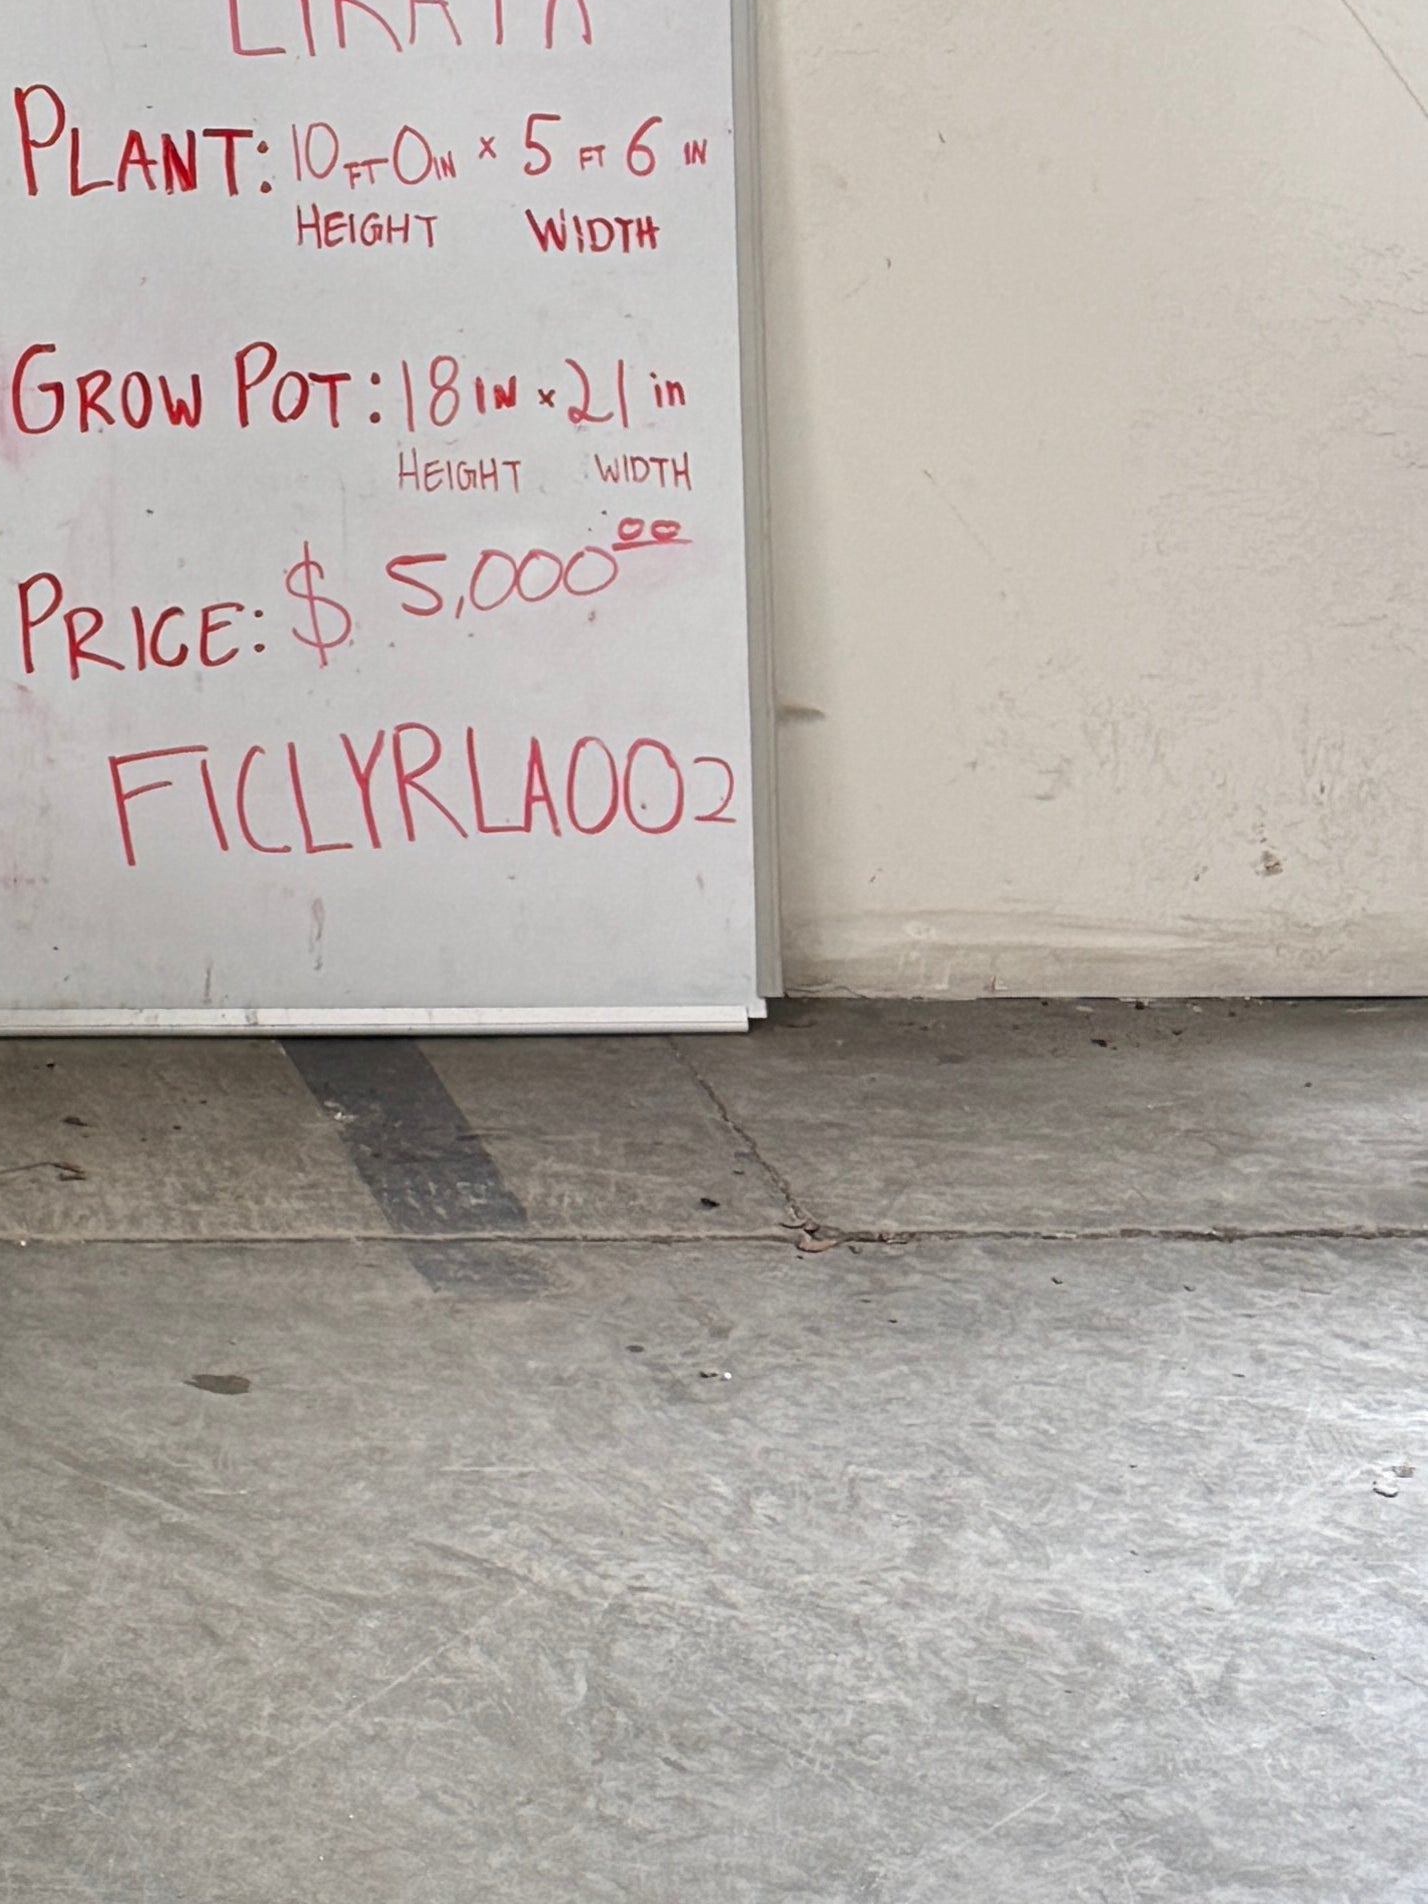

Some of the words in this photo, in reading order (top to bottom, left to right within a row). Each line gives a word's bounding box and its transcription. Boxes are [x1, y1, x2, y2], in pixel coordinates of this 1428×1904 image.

[12, 85, 272, 198] PLANT:
[523, 112, 560, 177] 5
[577, 142, 607, 171] FT
[625, 116, 661, 178] 6
[681, 139, 708, 167] IN
[296, 203, 438, 249] HEIGHT
[525, 210, 660, 254] WIDTH
[11, 343, 203, 435] GROW
[233, 341, 380, 429] POT:
[566, 359, 628, 427] 21
[397, 450, 522, 492] HEIGHT
[594, 453, 693, 492] WIDTH
[16, 573, 266, 680] PRICE:
